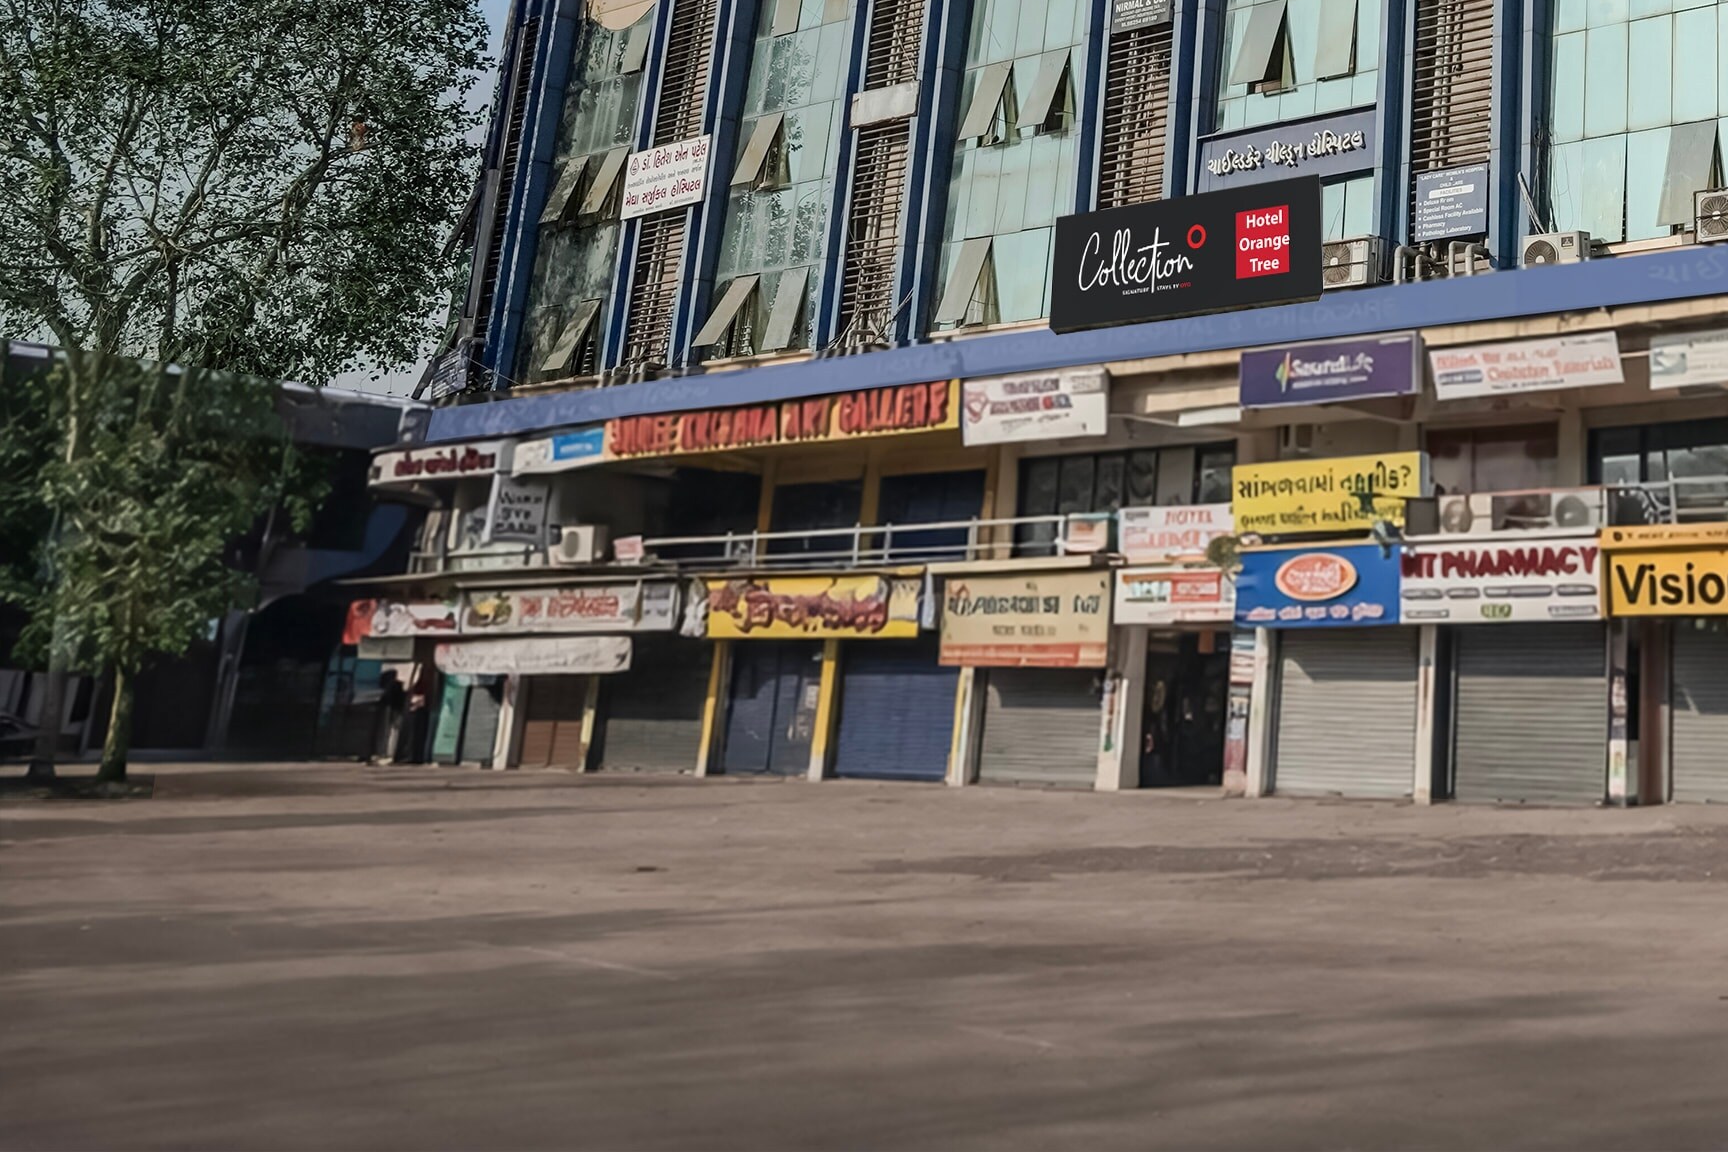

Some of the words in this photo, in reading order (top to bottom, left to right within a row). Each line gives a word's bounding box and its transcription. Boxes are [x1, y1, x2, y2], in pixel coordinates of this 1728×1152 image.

[1115, 0, 1144, 13] NIRMAL
[1307, 129, 1365, 157] હોસ્પિટલ
[1246, 209, 1283, 229] Hotel
[1422, 229, 1445, 237] Pathology
[1446, 225, 1472, 233] Laboratory
[1239, 233, 1291, 252] Orange
[1078, 226, 1194, 293] Collection
[1249, 257, 1280, 273] Tree
[1440, 546, 1598, 578] PHARMACY
